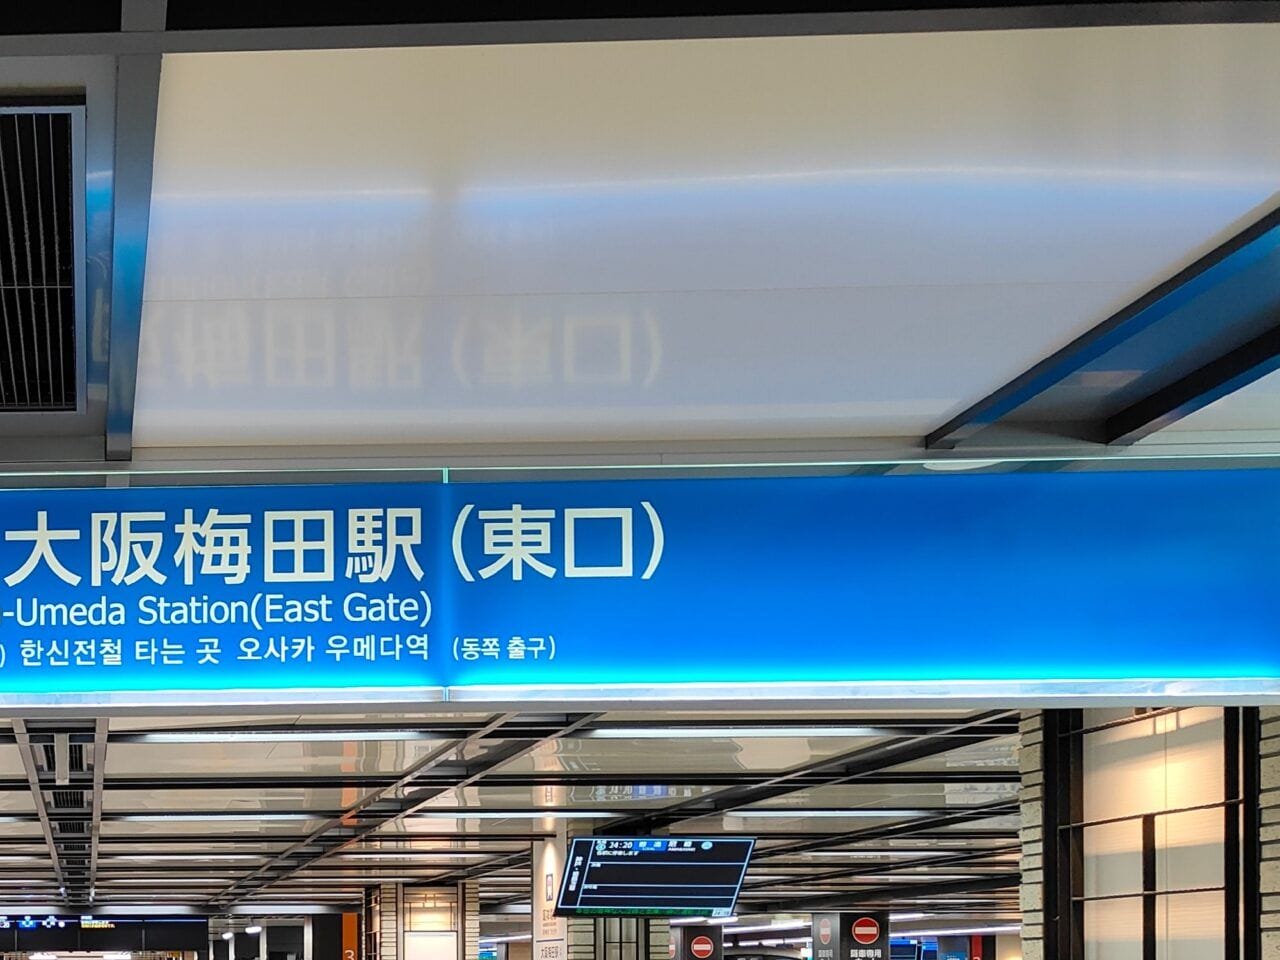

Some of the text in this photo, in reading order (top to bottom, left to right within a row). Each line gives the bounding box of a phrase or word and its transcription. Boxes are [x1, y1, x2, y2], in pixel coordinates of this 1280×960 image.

[343, 590, 432, 628] Gate)
[20, 634, 557, 666] 한신전철 타는 곳 오사카 우메다역 (동쪽 출구)
